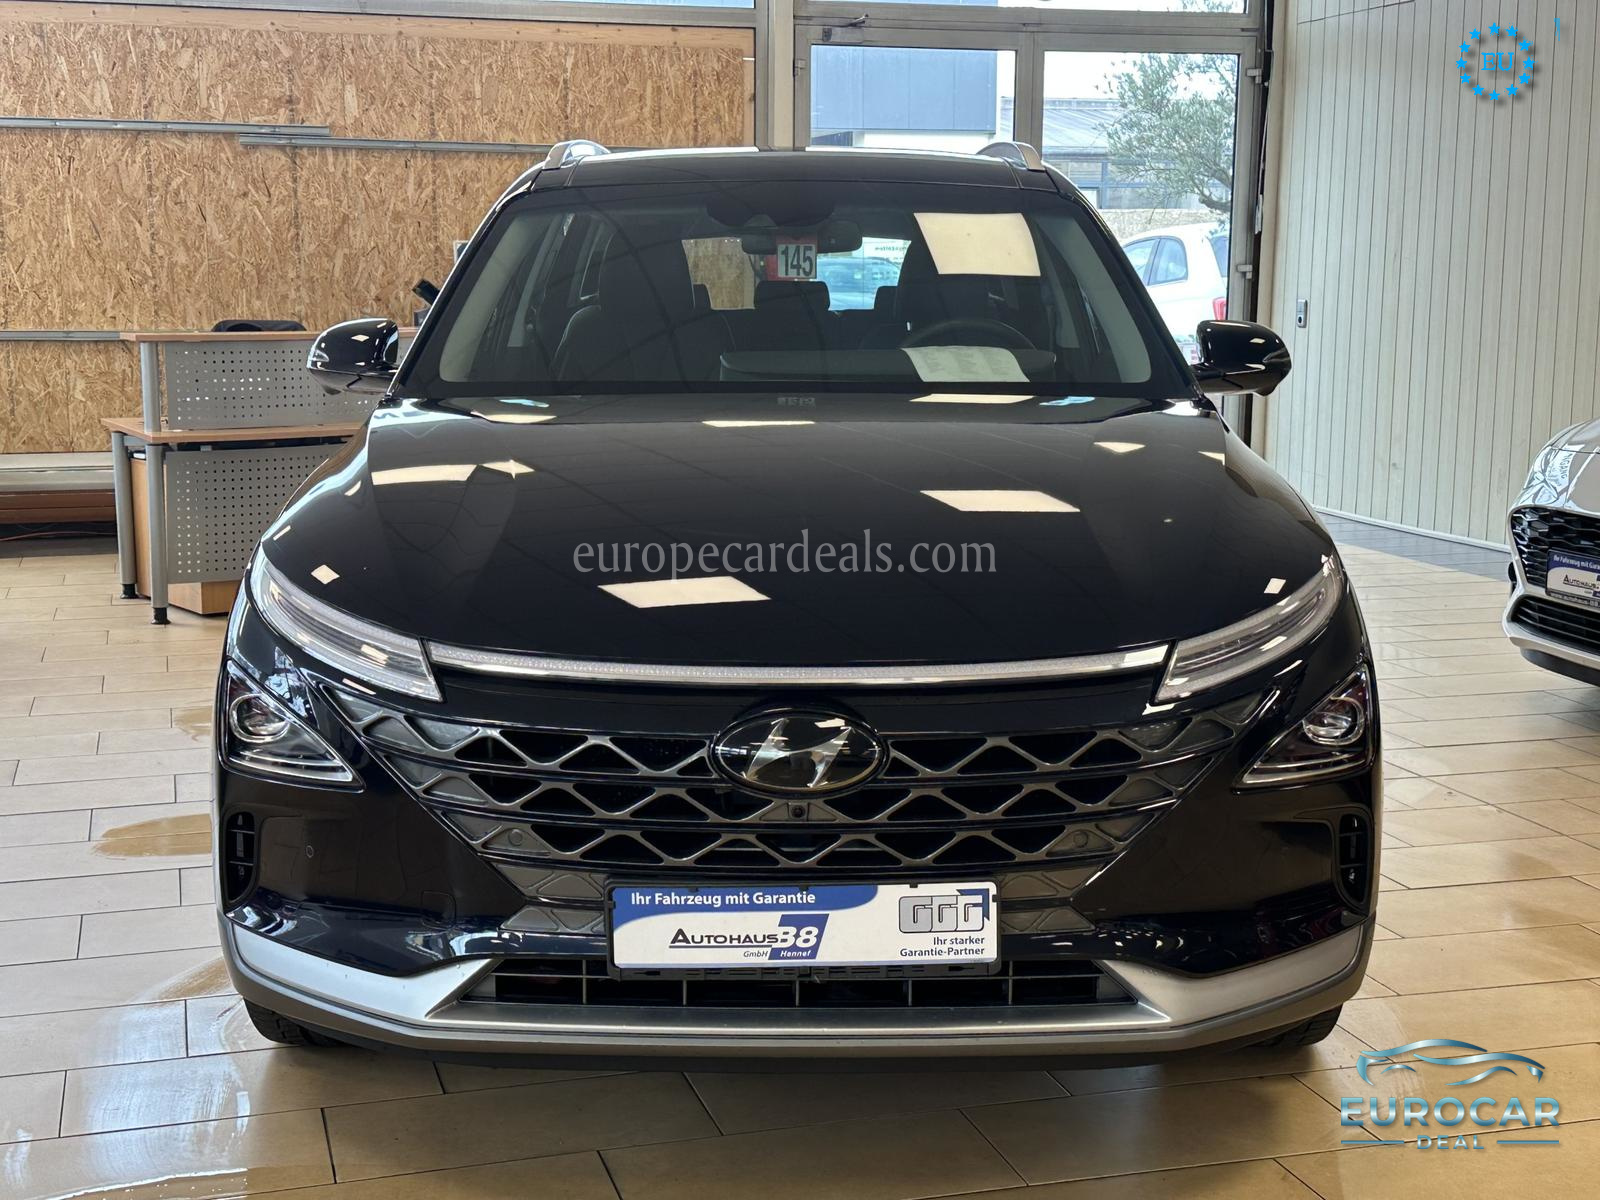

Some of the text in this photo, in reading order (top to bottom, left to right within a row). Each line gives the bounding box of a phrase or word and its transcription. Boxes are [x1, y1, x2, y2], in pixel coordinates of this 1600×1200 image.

[780, 245, 814, 277] 145
[631, 891, 816, 907] Ihr Fahrzeug mit Garantie
[899, 894, 985, 933] GGG
[933, 936, 985, 945] Ihr starker
[900, 947, 985, 957] Garantie-Partner
